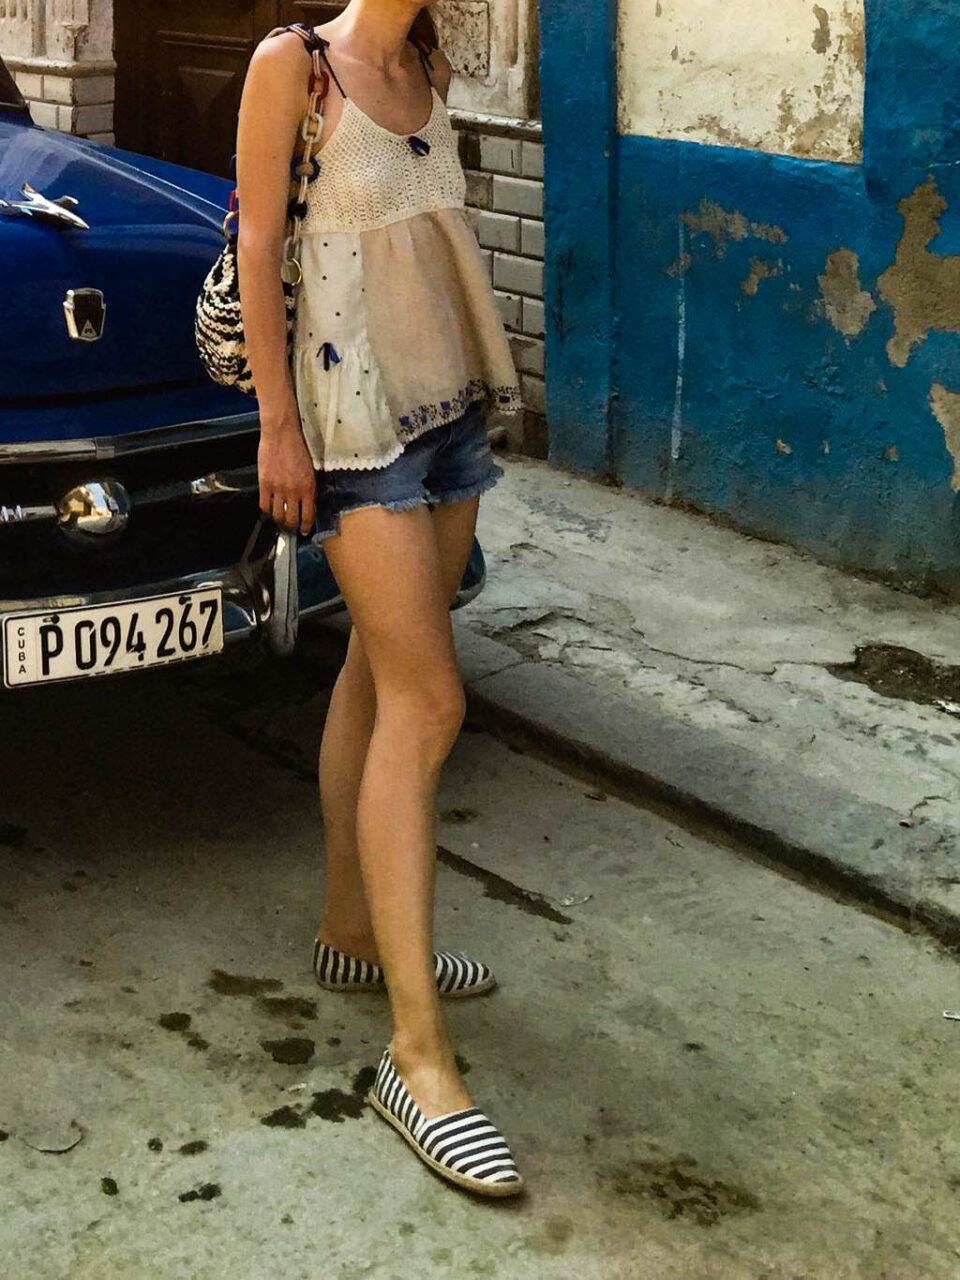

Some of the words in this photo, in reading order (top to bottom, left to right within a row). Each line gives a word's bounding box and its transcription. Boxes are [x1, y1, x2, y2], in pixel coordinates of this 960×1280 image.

[17, 627, 27, 674] CUBA
[39, 624, 64, 676] P
[74, 612, 147, 670] 094
[155, 598, 219, 658] 267
